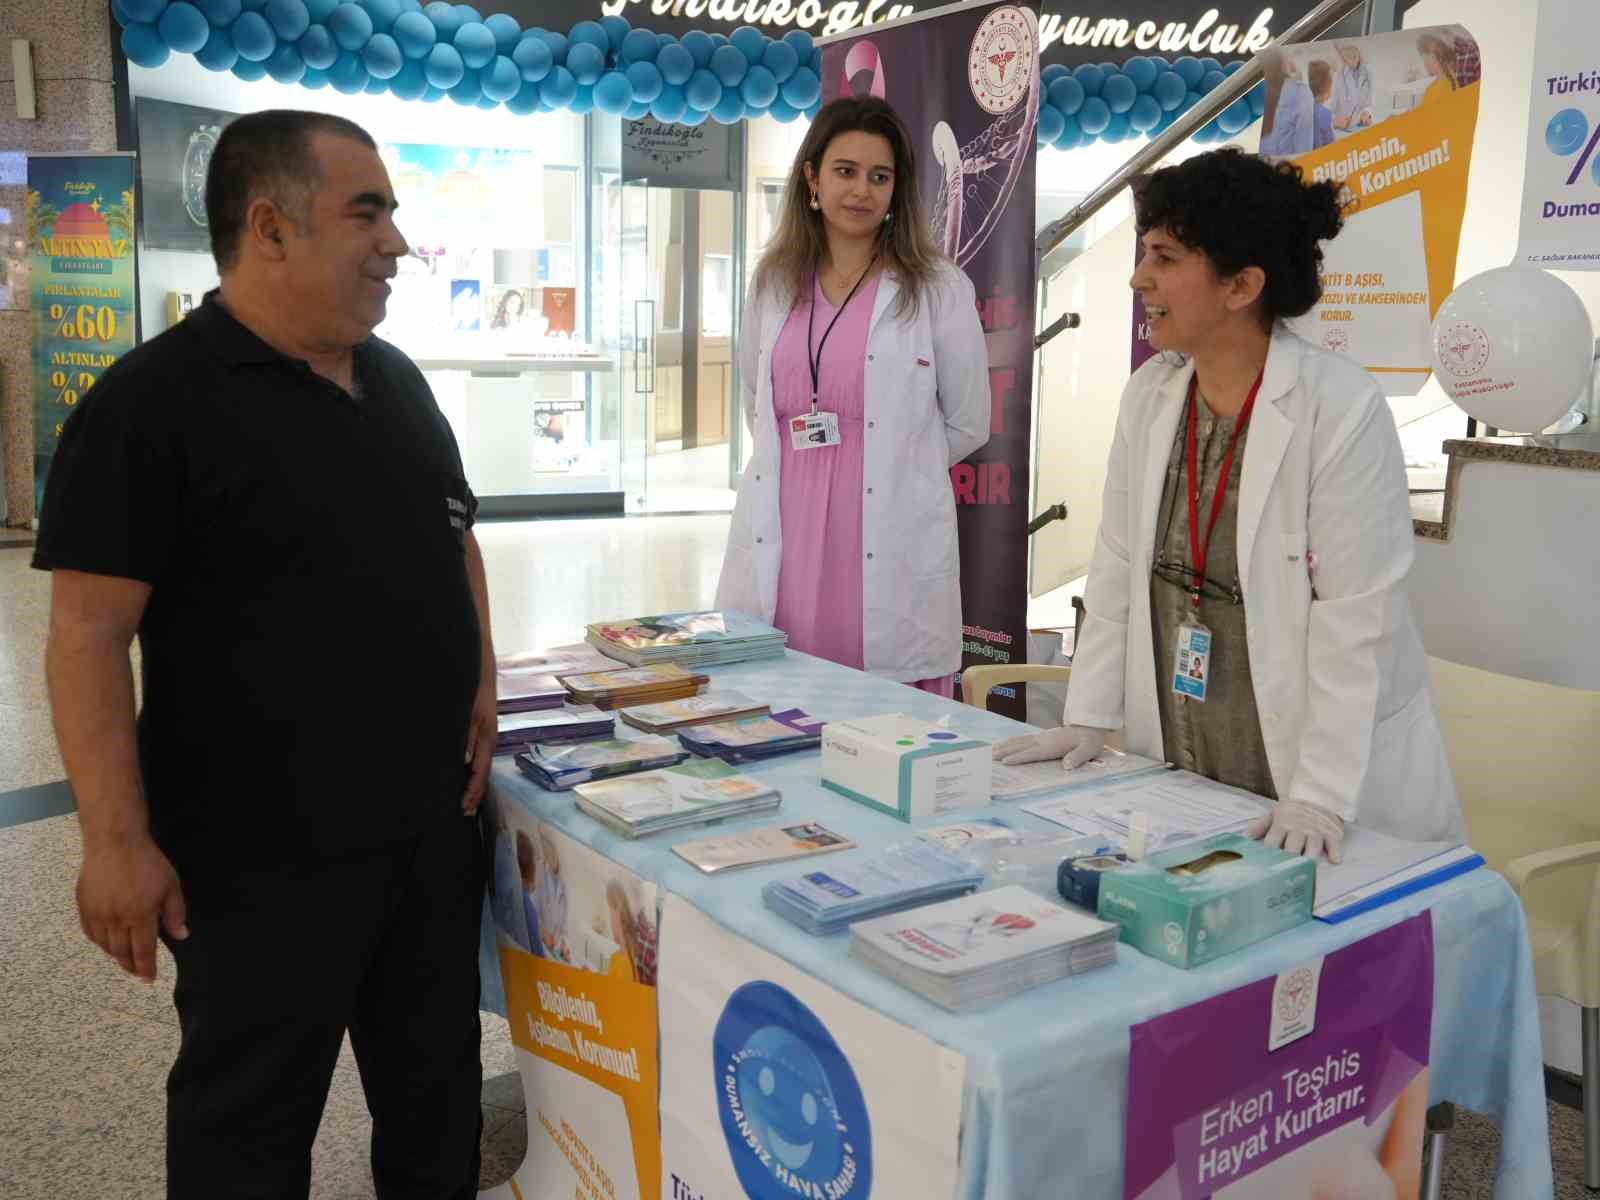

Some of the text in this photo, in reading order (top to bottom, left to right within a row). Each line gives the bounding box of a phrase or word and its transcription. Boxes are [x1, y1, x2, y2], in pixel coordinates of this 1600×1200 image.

[1360, 138, 1450, 196] Korunun!
[536, 980, 603, 1036] Bilgilenin,
[724, 1074, 772, 1168] DUMANSIZ
[775, 1162, 826, 1200] HAVA
[1198, 1084, 1366, 1185] Hayat Kurtarır.
[1201, 1049, 1361, 1147] Erken Teşhis
